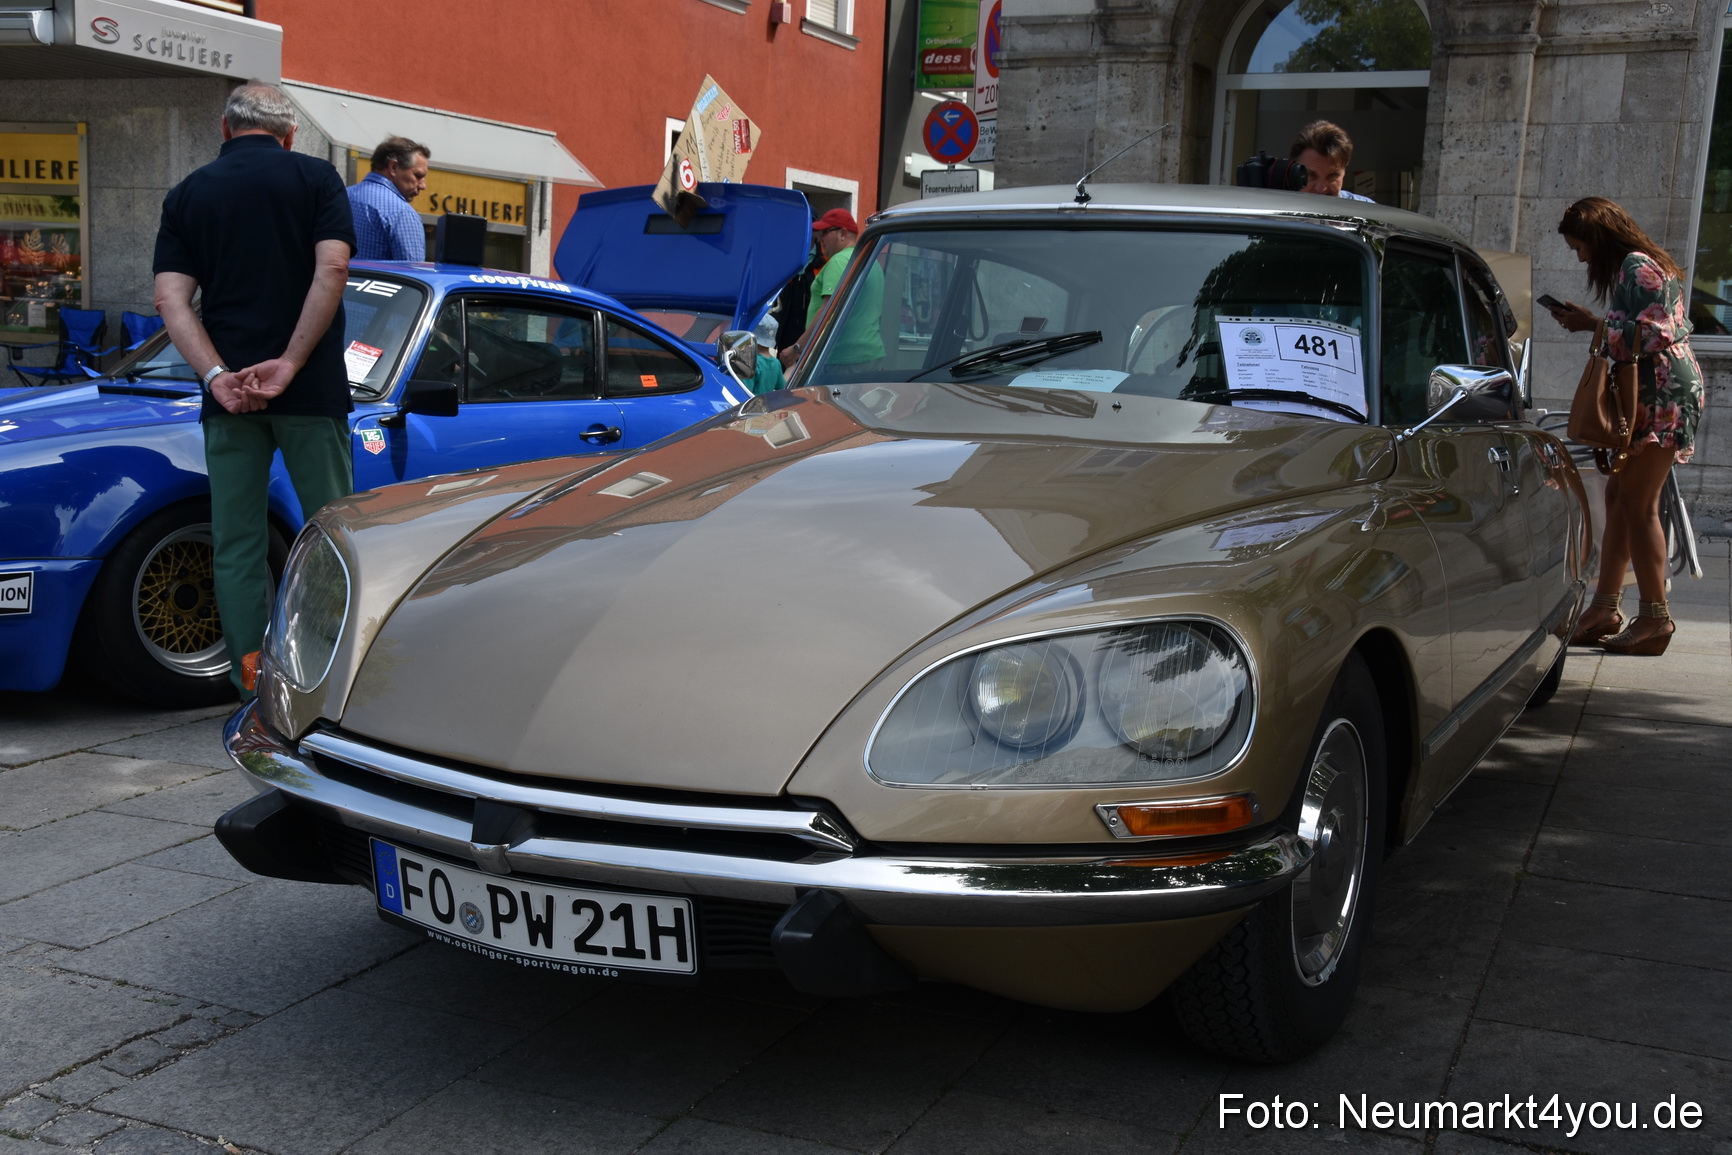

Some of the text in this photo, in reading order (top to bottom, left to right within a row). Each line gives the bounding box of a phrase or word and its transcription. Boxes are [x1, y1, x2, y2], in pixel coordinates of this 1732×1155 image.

[133, 34, 233, 69] SCHLIERF
[925, 53, 962, 64] dess
[733, 120, 741, 153] 20W-50
[0, 159, 79, 180] LIERF
[925, 184, 975, 194] Feuerwehrzufahrt
[429, 193, 524, 222] SCHLIERF
[469, 274, 571, 293] GOODYEAR
[1294, 334, 1339, 360] 481
[364, 431, 380, 441] TAG
[386, 883, 395, 899] D
[400, 858, 689, 963] FO PW 21H
[427, 929, 619, 977] www.oettinger-sportwagen.de
